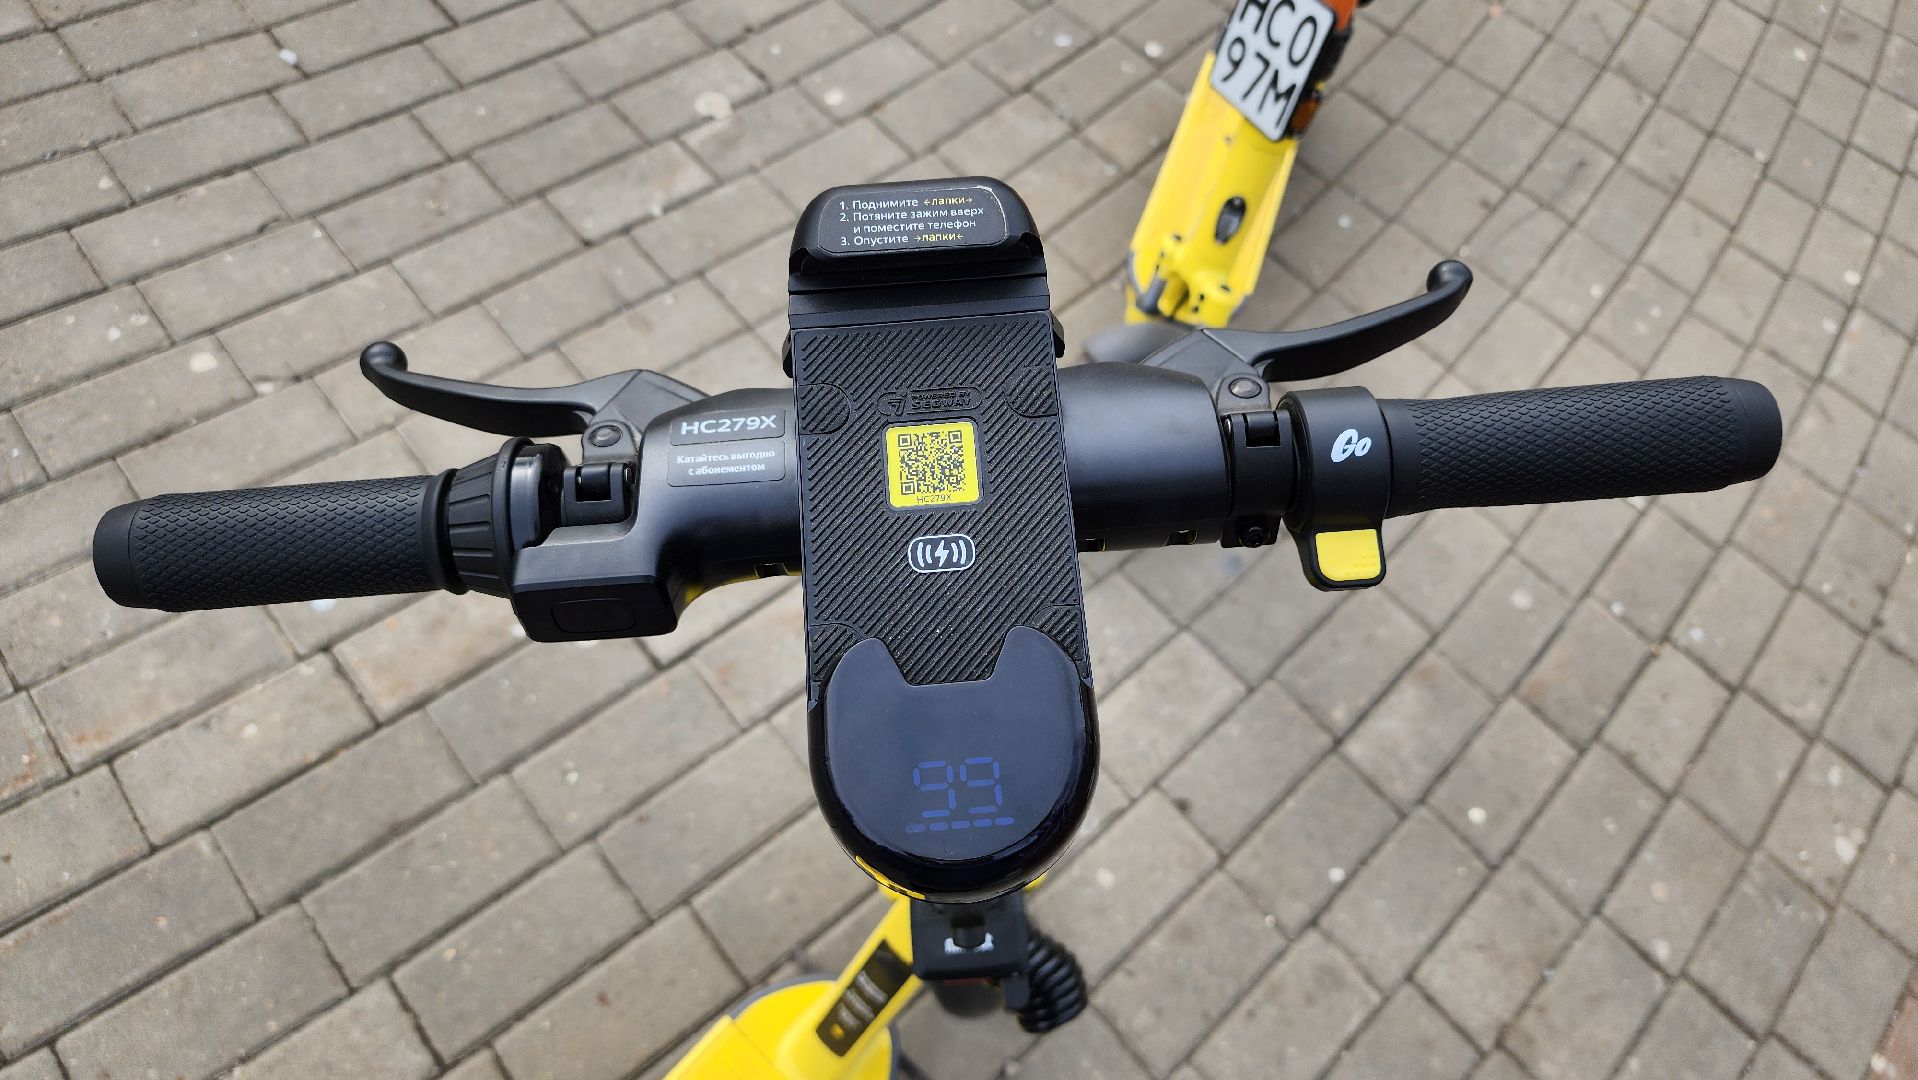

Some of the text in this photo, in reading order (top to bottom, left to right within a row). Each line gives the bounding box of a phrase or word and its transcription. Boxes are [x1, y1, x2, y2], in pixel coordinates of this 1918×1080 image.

[852, 199, 919, 211] Поднимите
[839, 207, 985, 222] 2. Потяните зажим вверх
[853, 219, 977, 234] и поместите телефон
[840, 236, 851, 246] 3.
[853, 235, 909, 247] Опустите
[911, 399, 971, 410] SEGWAY
[680, 415, 777, 435] HC279X
[1330, 428, 1373, 463] Go
[677, 450, 775, 464] Катайтесь выгодно
[695, 463, 766, 475] абонементом
[916, 494, 953, 504] HC279X
[912, 756, 1004, 819] 99
